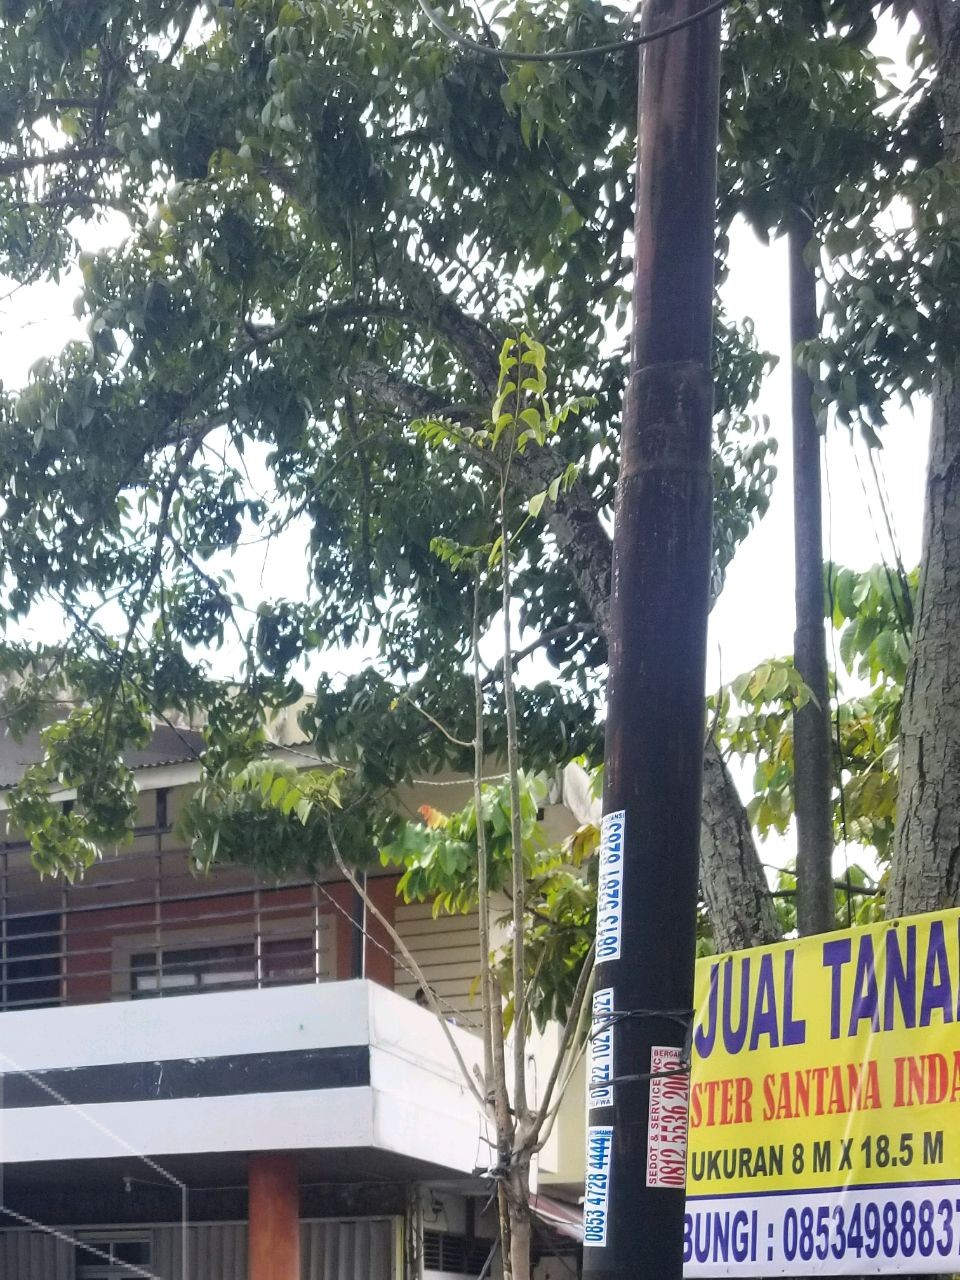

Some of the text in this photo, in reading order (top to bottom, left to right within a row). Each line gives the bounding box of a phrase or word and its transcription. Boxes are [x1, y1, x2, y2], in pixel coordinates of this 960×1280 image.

[694, 917, 960, 1059] JUAL TANA
[651, 1079, 661, 1129] SERVICE
[762, 1059, 882, 1122] SANTANA
[650, 1134, 658, 1142] &
[660, 1105, 688, 1144] 5536
[589, 1137, 611, 1170] 4444
[649, 1146, 658, 1184] SEDOT
[659, 1148, 686, 1185] 0812
[691, 1130, 944, 1182] UKURAN 8 M X 18.5 M
[586, 1174, 608, 1206] 4728
[585, 1210, 605, 1242] 0853
